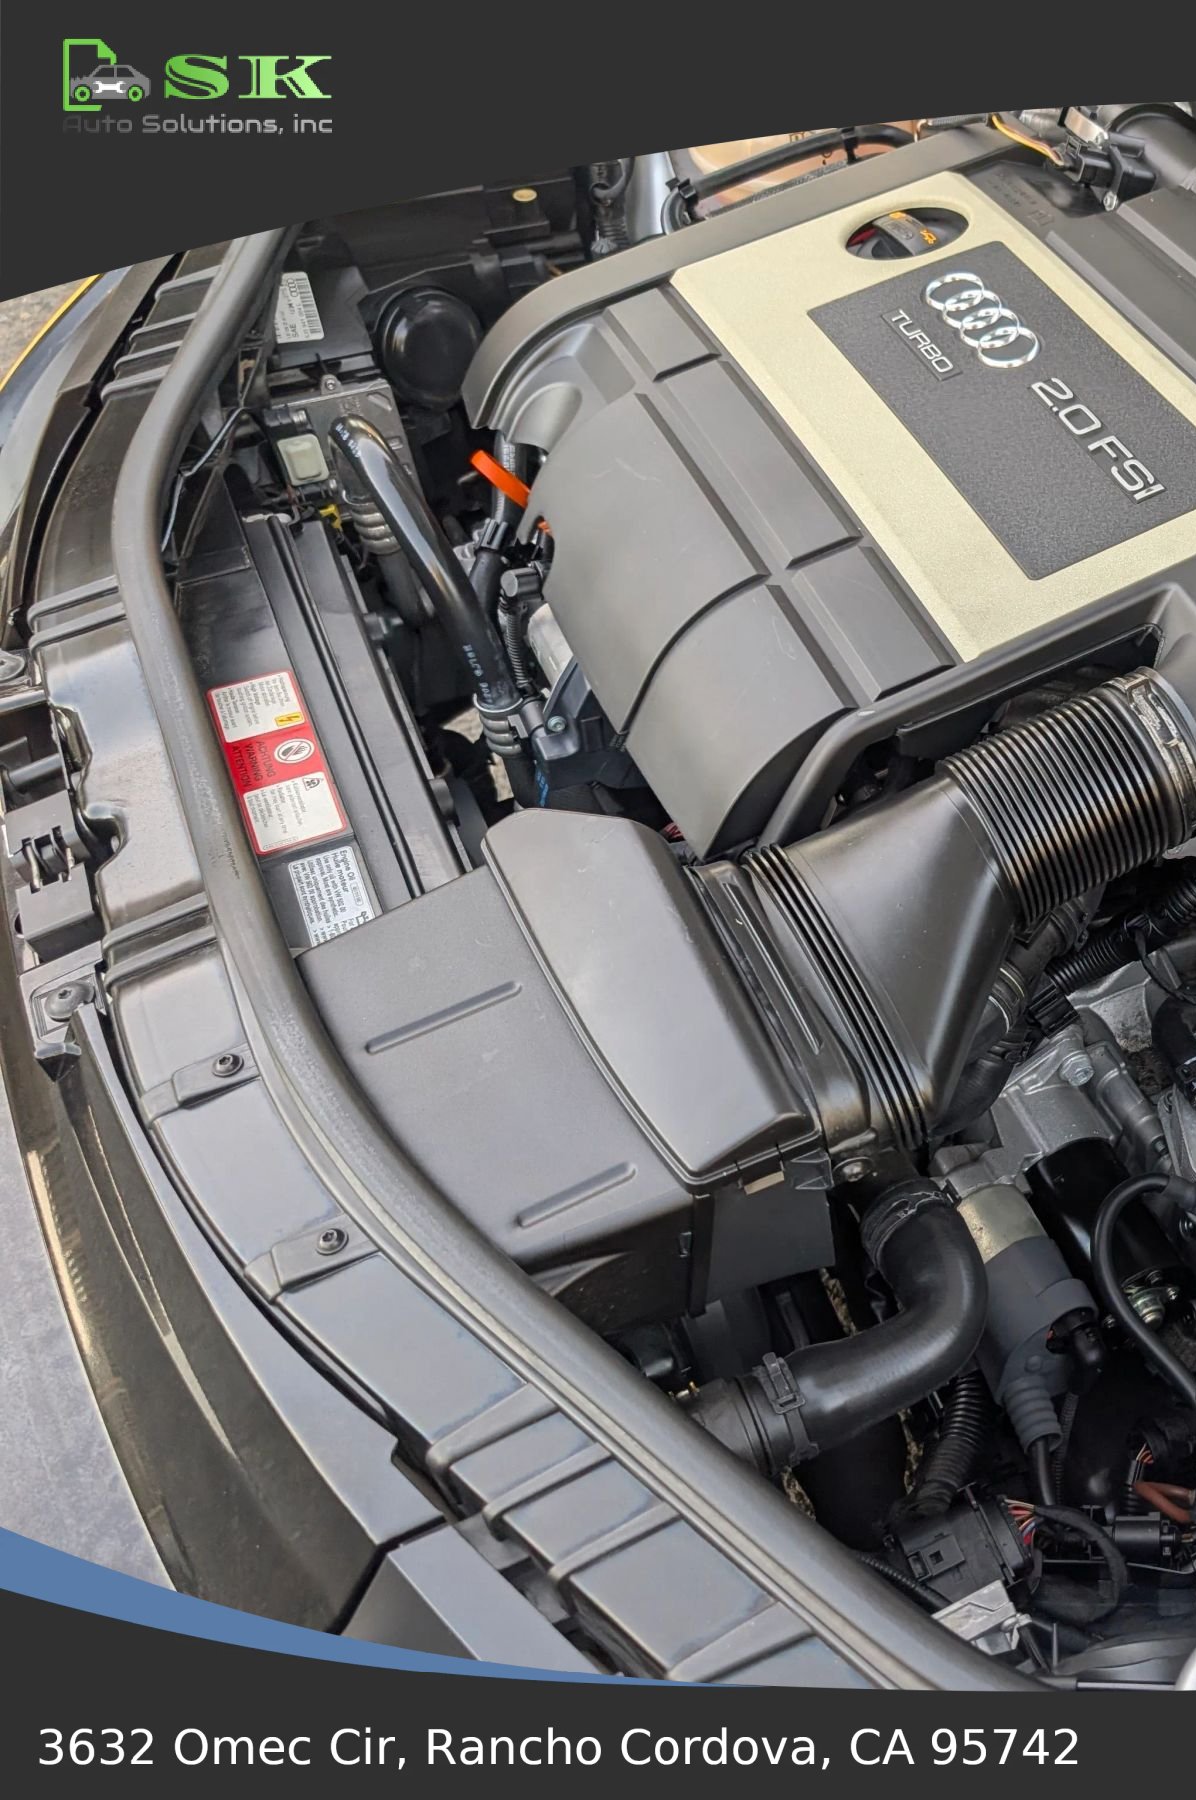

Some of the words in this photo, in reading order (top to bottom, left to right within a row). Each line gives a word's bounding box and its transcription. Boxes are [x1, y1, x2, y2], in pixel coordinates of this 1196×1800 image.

[891, 309, 953, 373] TURBO
[1031, 377, 1101, 436] 2.0
[1087, 435, 1165, 501] FSI
[230, 745, 251, 787] ATTENTION
[243, 743, 263, 781] WARNING
[256, 739, 276, 777] ACHTUNG
[337, 869, 349, 892] moteur
[338, 850, 352, 871] Engine
[347, 871, 355, 881] Oil
